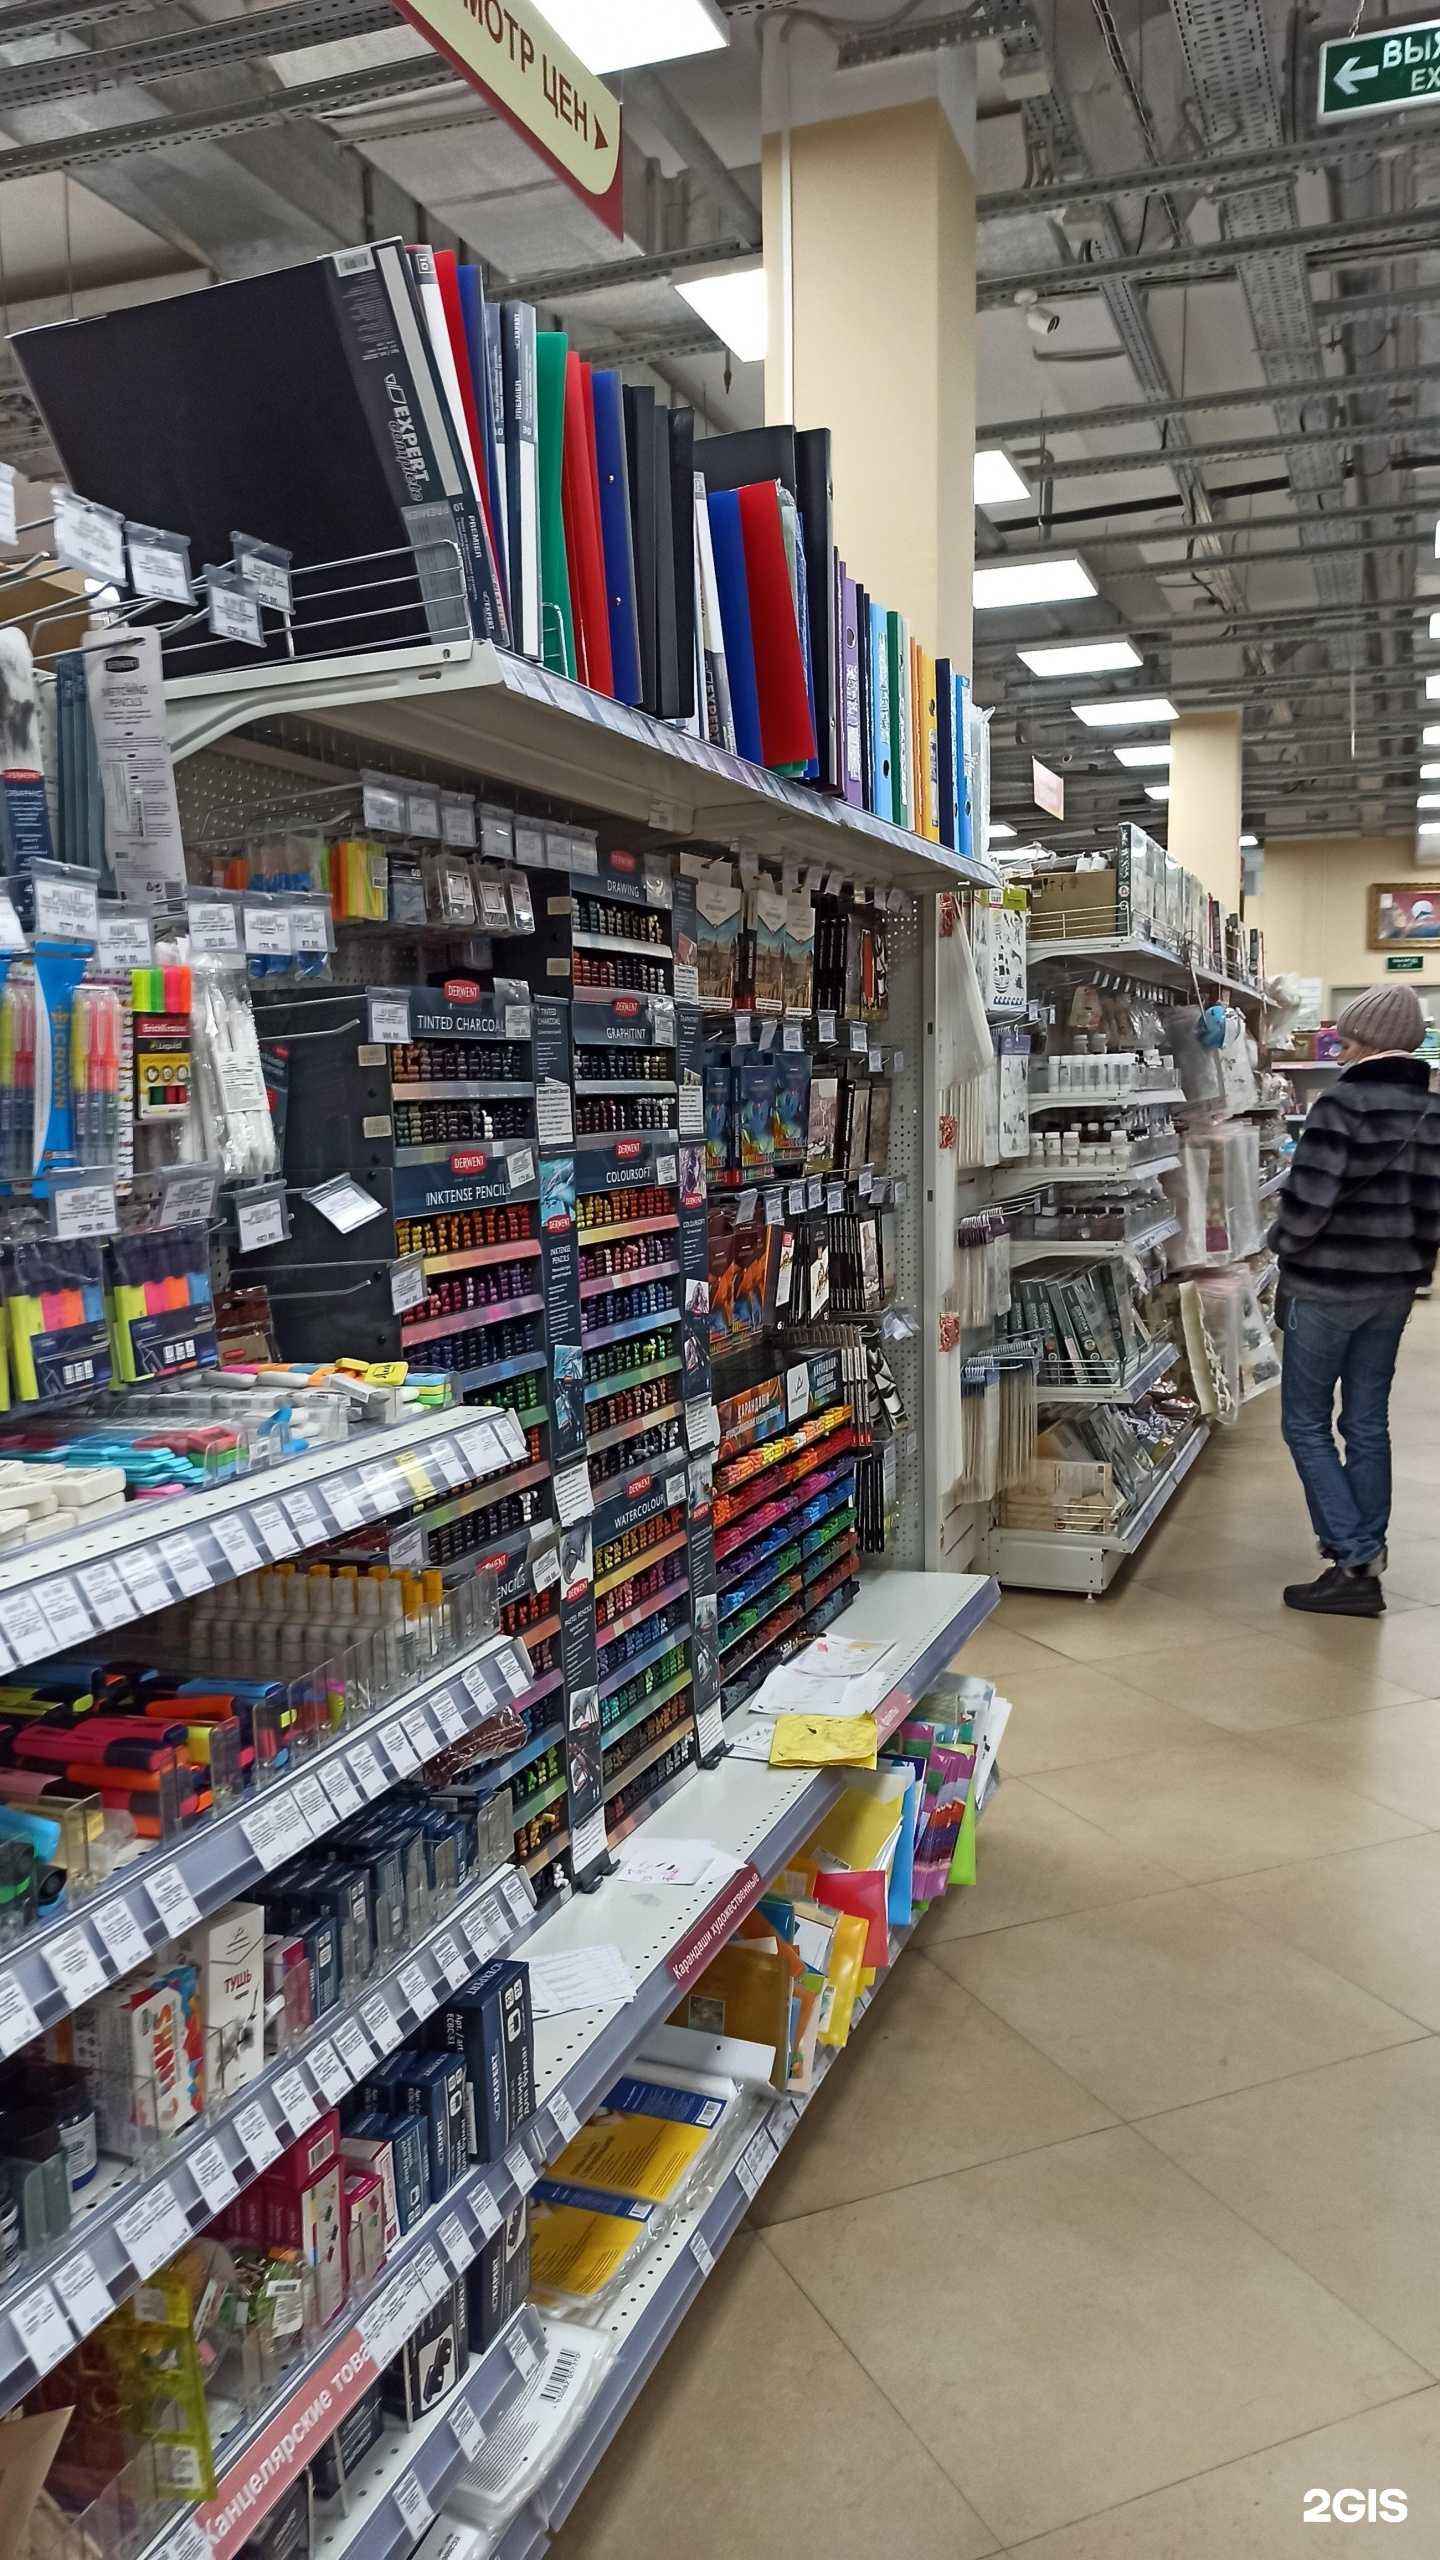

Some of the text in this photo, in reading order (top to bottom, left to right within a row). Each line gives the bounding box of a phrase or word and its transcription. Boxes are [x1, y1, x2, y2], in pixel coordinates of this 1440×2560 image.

[542, 54, 588, 142] ЦЕН
[393, 404, 431, 482] EXPERT
[467, 515, 483, 559] PREMIER
[607, 880, 640, 898] DRAWING
[448, 985, 479, 998] DERWENT
[615, 1001, 639, 1013] DERWENT
[417, 1015, 453, 1030] TINTED
[606, 1027, 646, 1039] GRAPHITINT
[617, 1142, 642, 1154] DERWENT
[454, 1156, 484, 1169] DERWENT
[606, 1166, 652, 1184] COLOURSOFT
[425, 1187, 474, 1206] INKTENSE
[548, 1218, 571, 1230] DERWENT
[628, 1476, 652, 1496] DERWENT
[614, 1496, 666, 1529] WATERCOLOUR
[567, 1581, 588, 1601] DERWENT
[672, 1872, 761, 1980] Карандаши художественные
[224, 1968, 253, 1994] ТУШЬ
[466, 1969, 496, 1996] EXPERT
[490, 2055, 501, 2102] EXPERT
